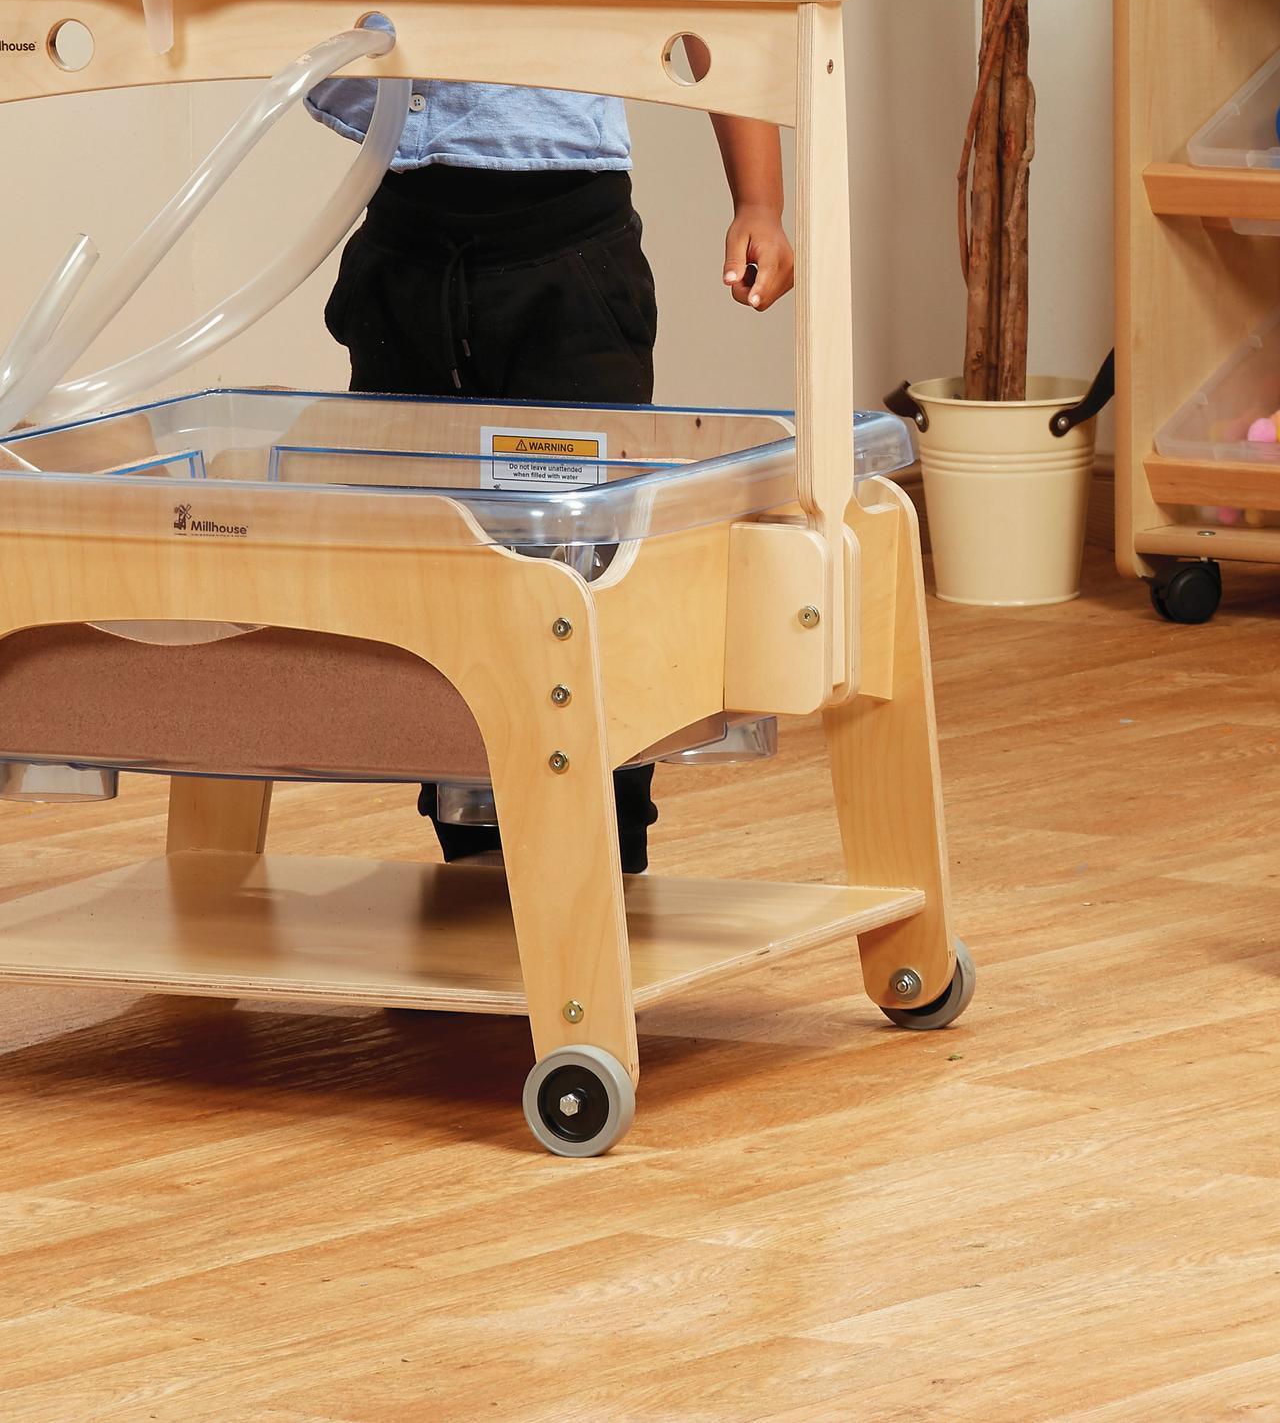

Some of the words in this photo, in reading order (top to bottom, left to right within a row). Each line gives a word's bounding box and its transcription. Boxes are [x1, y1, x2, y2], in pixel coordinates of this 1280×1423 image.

[528, 442, 574, 452] WARNING
[548, 465, 583, 473] unattended
[547, 472, 561, 480] with
[190, 520, 248, 535] Millhouse
